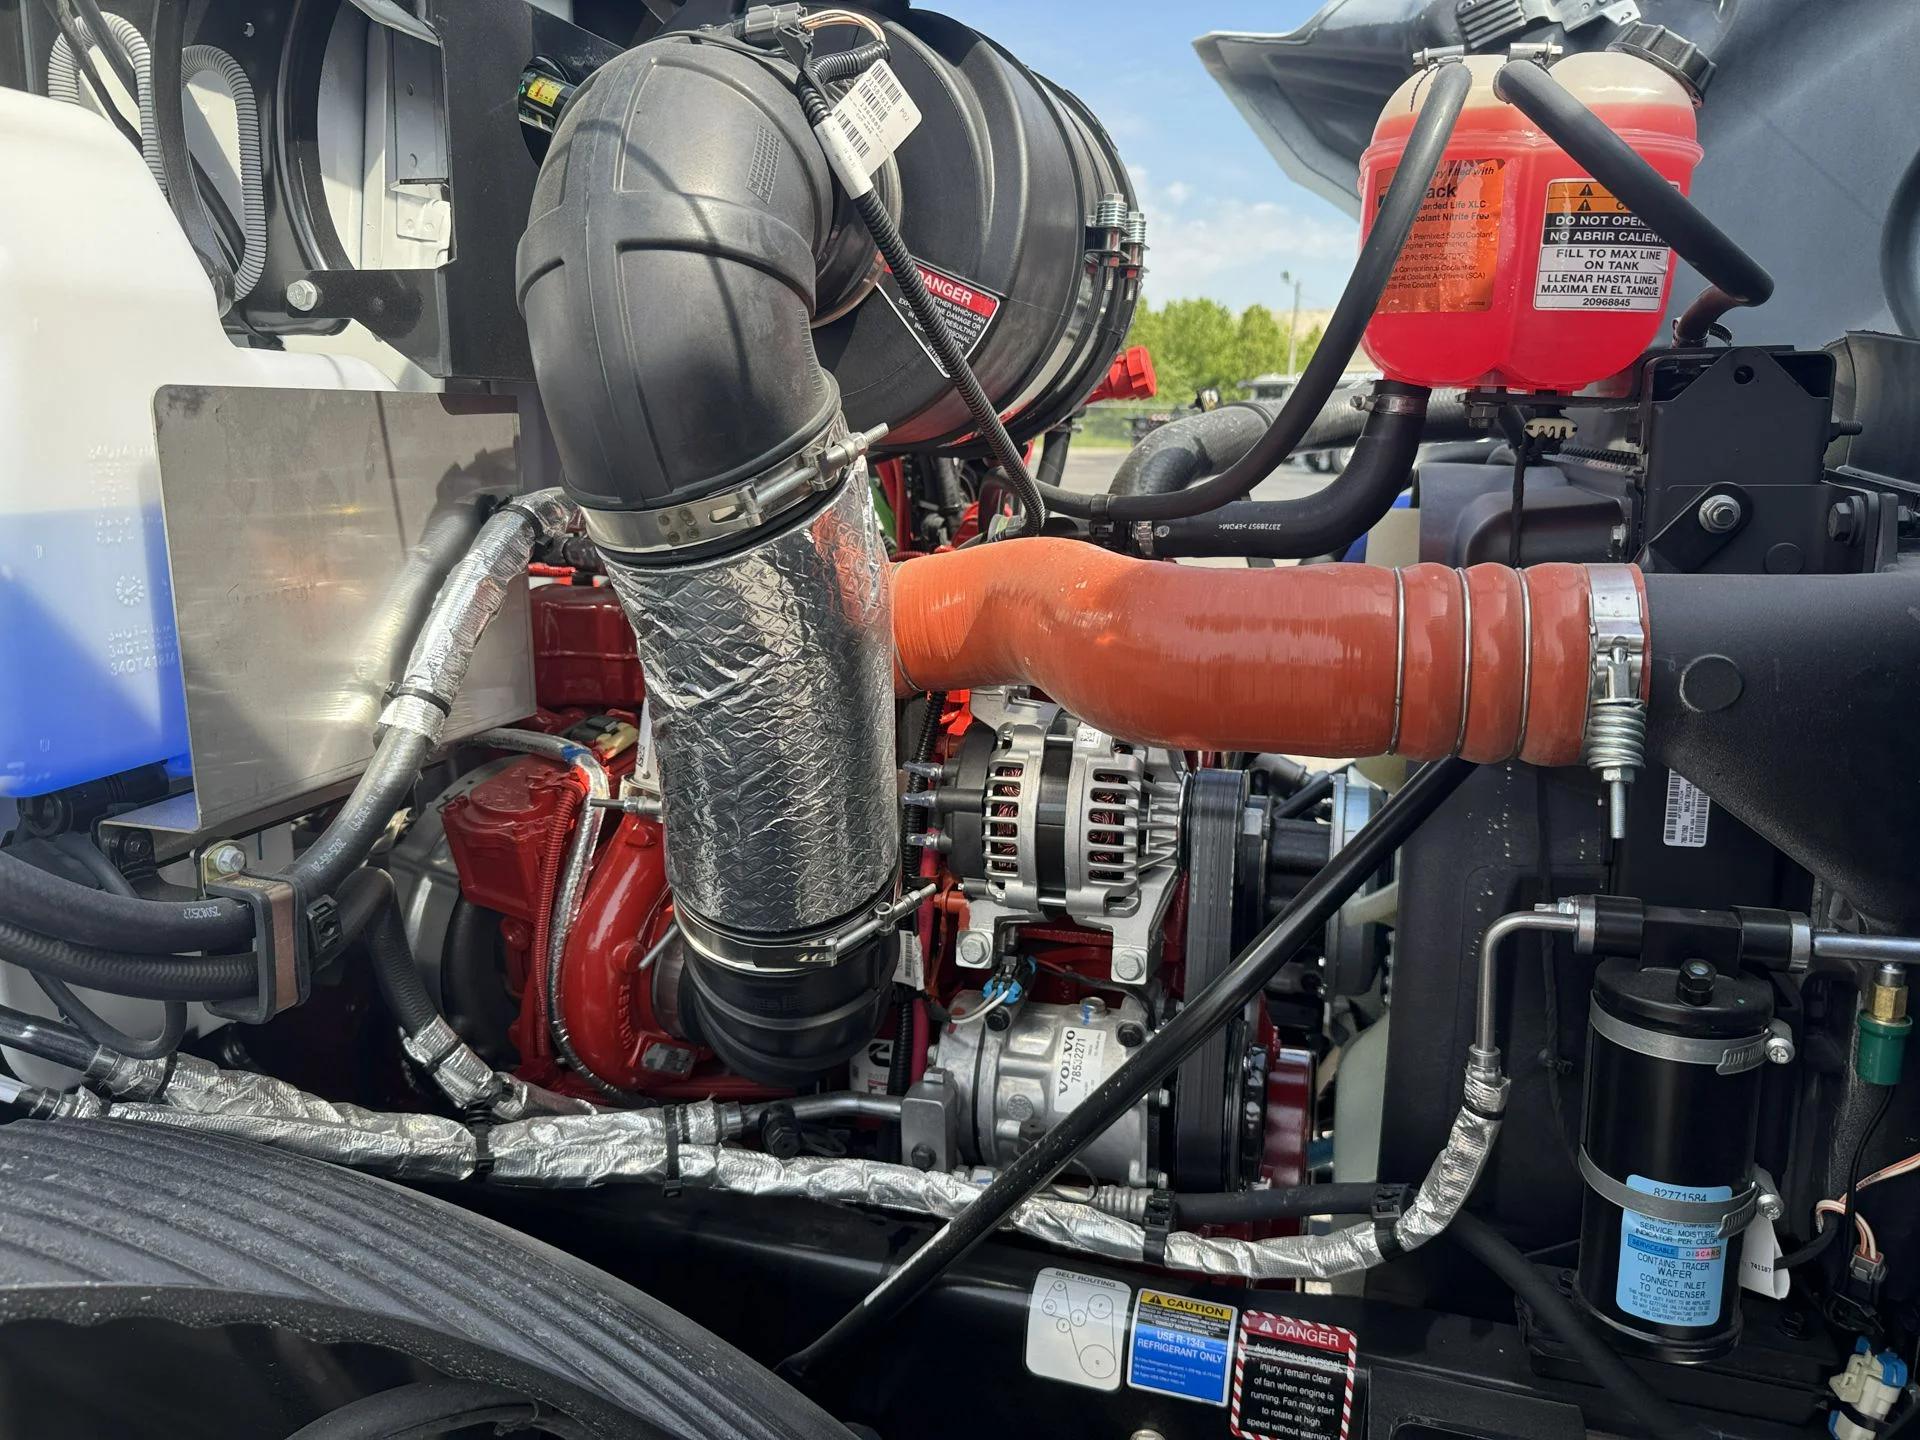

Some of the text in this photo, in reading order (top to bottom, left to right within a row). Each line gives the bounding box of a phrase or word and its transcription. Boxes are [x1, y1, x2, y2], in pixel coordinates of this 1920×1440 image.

[1474, 167, 1495, 175] with
[1426, 183, 1457, 199] ack
[1419, 200, 1486, 210] ended Life XLC
[1415, 212, 1490, 222] oolant Nitrite Free
[1555, 216, 1576, 226] DO
[1580, 216, 1609, 226] NOT
[1550, 231, 1665, 243] NO ABRIR CALIEN
[1556, 249, 1661, 260] FILL TO MAX LINE
[1584, 261, 1640, 270] ON TANK
[1547, 274, 1657, 285] LLENAR HASTA LINEA
[1541, 285, 1659, 295] MAXIMA EN EL TANQUE
[1583, 298, 1631, 307] 20968845
[946, 309, 971, 326] DAMAGE
[971, 320, 982, 331] OR
[952, 304, 972, 317] WHICH
[973, 311, 986, 324] CAN
[1059, 1030, 1076, 1096] VOLVO
[1635, 1228, 1673, 1243] INDICATOR
[1678, 1236, 1692, 1244] PER
[1640, 1222, 1715, 1238] SERVICE MOISTURE
[1631, 1237, 1721, 1257] SERVICEABLE DISCARD
[1637, 1252, 1710, 1271] CONTAINS TRACER
[1055, 1271, 1116, 1288] BELT ROUTING
[1640, 1272, 1706, 1289] CONNECT INLET
[1658, 1266, 1692, 1279] WAFER
[1640, 1282, 1705, 1299] TO CONDENSER
[1167, 1298, 1224, 1316] CAUTION
[1156, 1330, 1206, 1349] USE R-134a
[1276, 1322, 1340, 1346] DANGER
[1137, 1338, 1223, 1363] REFRIGERANT ONLY
[1284, 1367, 1310, 1380] remain
[1312, 1372, 1331, 1385] clear
[1254, 1377, 1334, 1401] of fan when engine is
[1250, 1391, 1335, 1415] running. Fan may start
[1262, 1407, 1321, 1427] to rotate at high
[1246, 1418, 1270, 1430] speed
[1271, 1423, 1299, 1436] without
